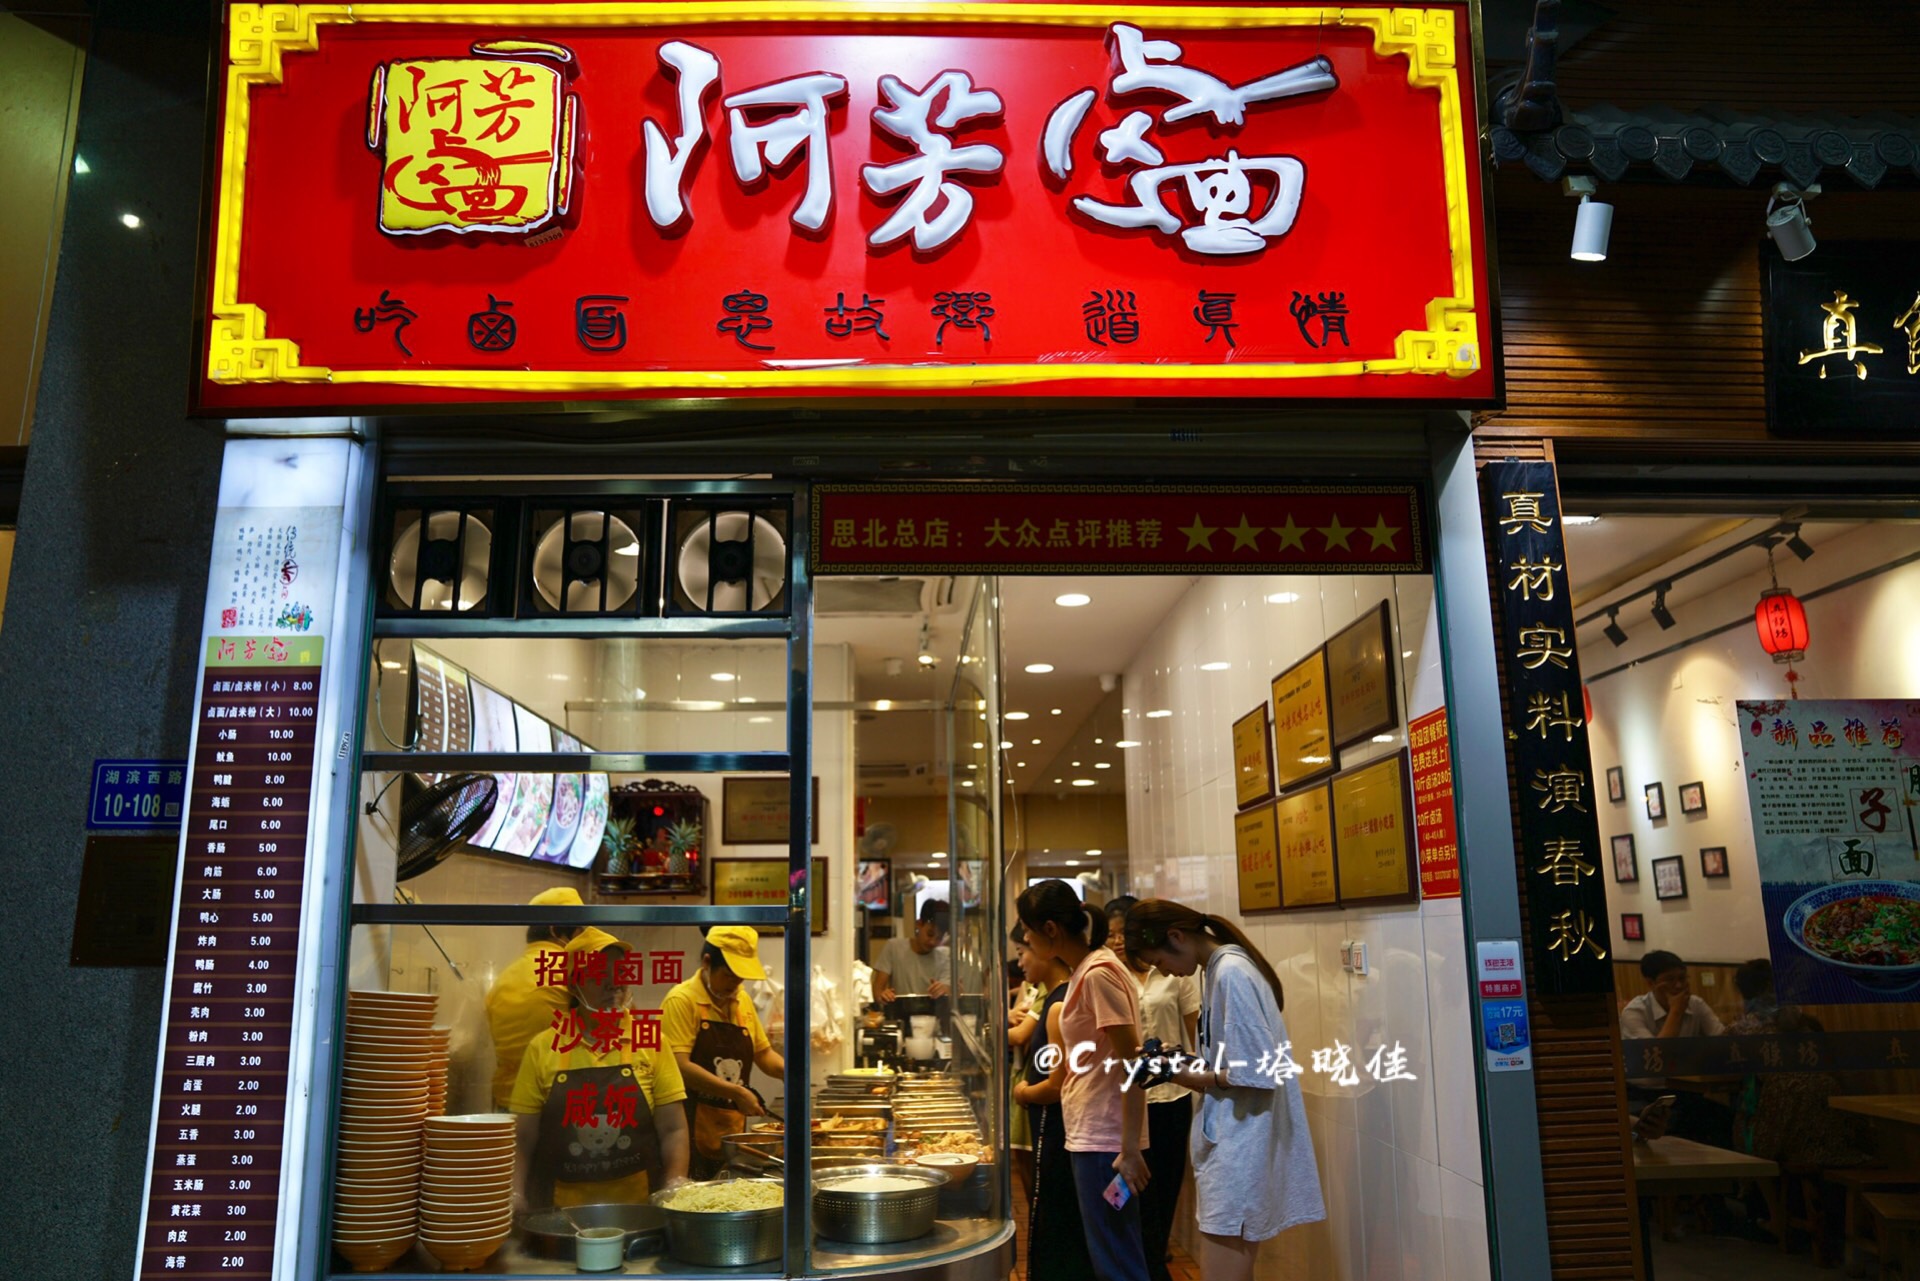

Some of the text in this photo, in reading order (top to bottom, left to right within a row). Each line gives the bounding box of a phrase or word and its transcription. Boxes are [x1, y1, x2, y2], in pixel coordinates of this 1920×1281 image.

[292, 681, 313, 691] 8.00
[288, 706, 314, 717] 10.00
[218, 728, 294, 741] 小肠 10.00
[1770, 717, 1905, 750] 新品推荐
[215, 751, 292, 763] 鱿鱼 10.00
[105, 770, 182, 785] 湖滨西路
[264, 774, 285, 785] 8.00
[262, 796, 284, 808] 6.00
[208, 818, 282, 831] 尾口 6.00
[207, 841, 226, 854] 香肠
[1838, 839, 1874, 879] 面
[203, 865, 278, 878] 肉筋 6.00
[202, 887, 275, 900] 大肠 5.00
[199, 911, 274, 924] 鸭心 5.00
[197, 935, 272, 947] 炸肉 5.00
[194, 958, 270, 971] 鸭肠 4.00
[534, 949, 685, 988] 招牌卤面
[192, 981, 268, 995] 腐竹 3.00
[244, 1007, 266, 1018] 3.00
[188, 1030, 264, 1043] 粉肉 3.00
[551, 1008, 664, 1054] 沙茶面
[185, 1054, 262, 1067] 三层肉 3.00
[182, 1078, 260, 1092] 卤蛋 2.00
[180, 1103, 258, 1116] 火腿 2.00
[562, 1083, 639, 1129] 咸饭
[178, 1128, 256, 1141] 五香 3.00
[175, 1153, 254, 1166] 蒸蛋 3.00
[172, 1178, 251, 1191] 玉米肠 3.00
[170, 1203, 202, 1217] 黄花菜
[167, 1229, 247, 1243] 肉皮 2.00
[164, 1255, 245, 1269] 海带 2.00
